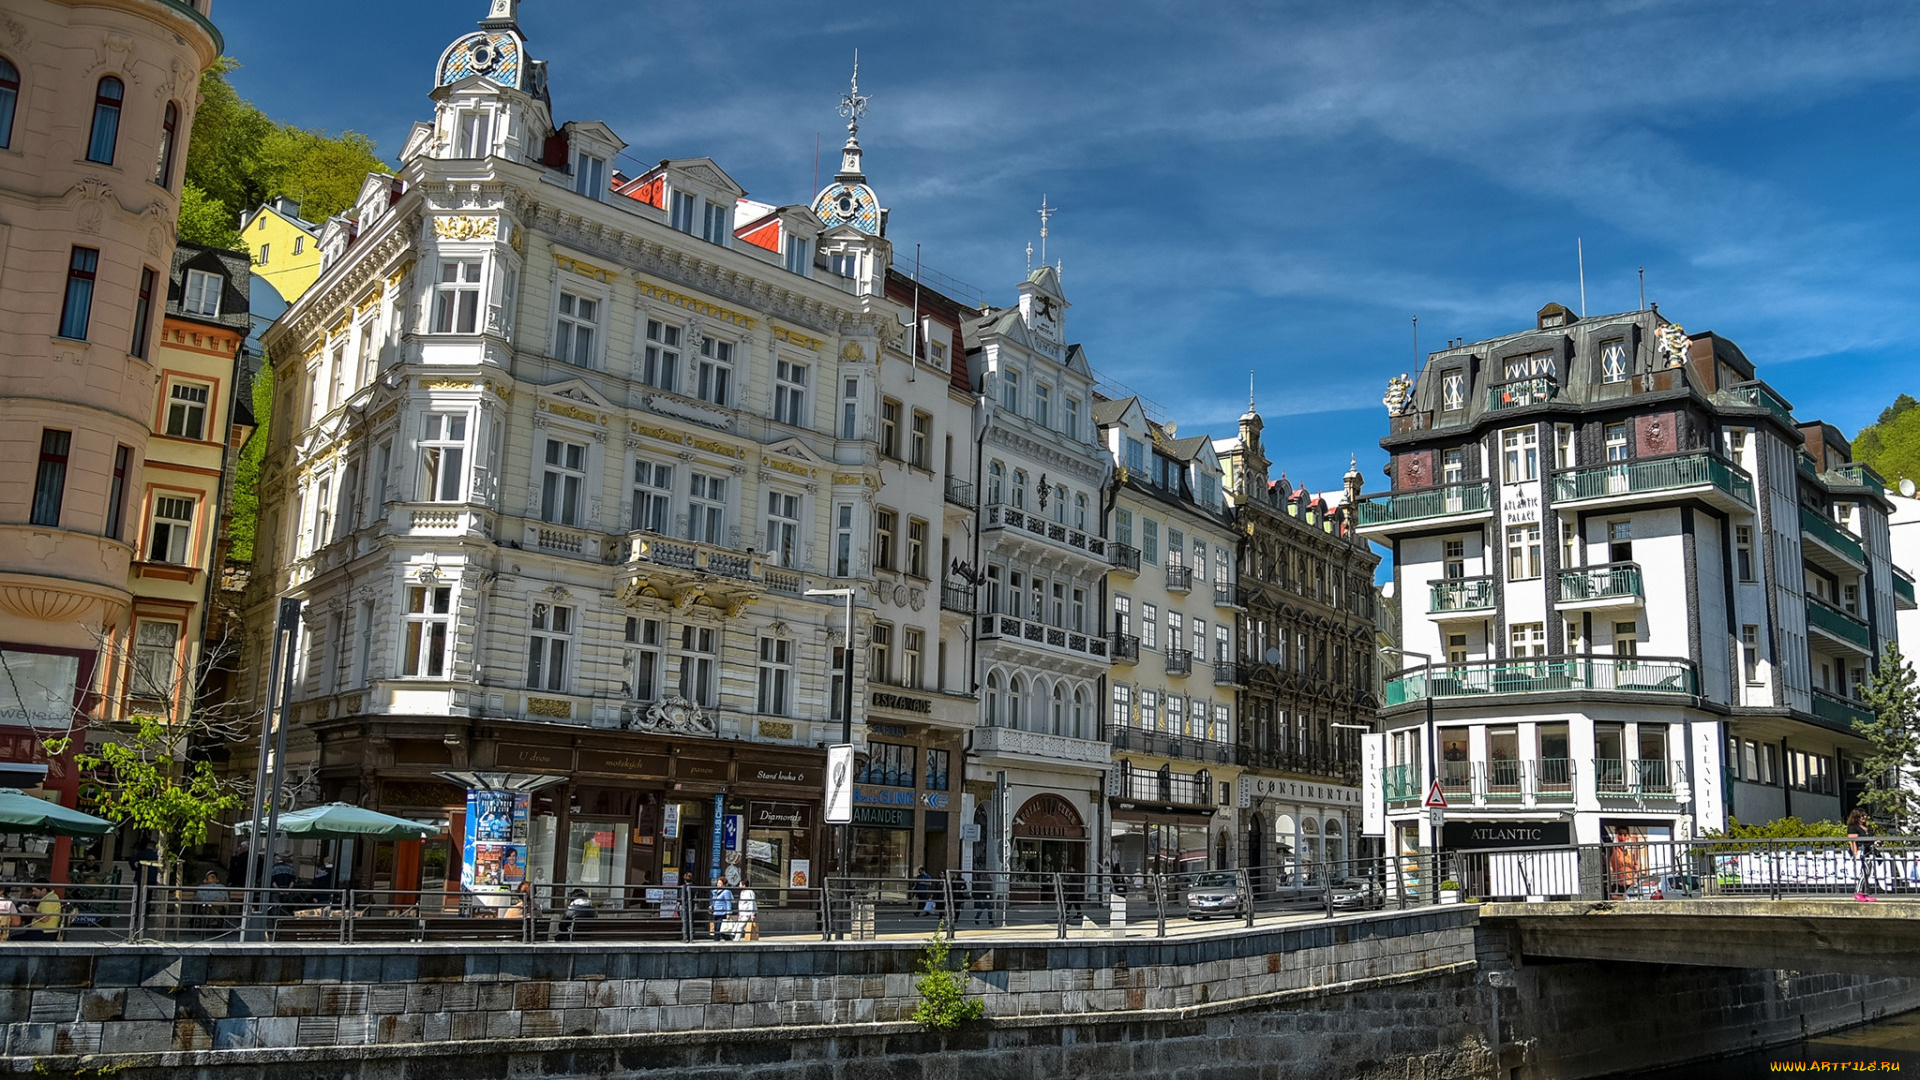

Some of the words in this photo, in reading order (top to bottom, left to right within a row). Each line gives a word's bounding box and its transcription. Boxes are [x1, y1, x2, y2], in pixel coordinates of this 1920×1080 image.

[1504, 497, 1538, 510] ATLANTIC
[1507, 510, 1535, 522] PALACE
[873, 692, 932, 713] ESPLANADE
[519, 751, 528, 761] U
[880, 789, 915, 805] CLINIC
[1257, 779, 1361, 803] CONTINENTAL
[759, 810, 802, 822] Diamonds
[853, 808, 903, 824] AMANDER
[1021, 801, 1041, 822] ROYAL
[1057, 802, 1078, 825] CZECH
[1030, 825, 1069, 837] SOUVENIR
[1470, 828, 1541, 840] ATLANTIC
